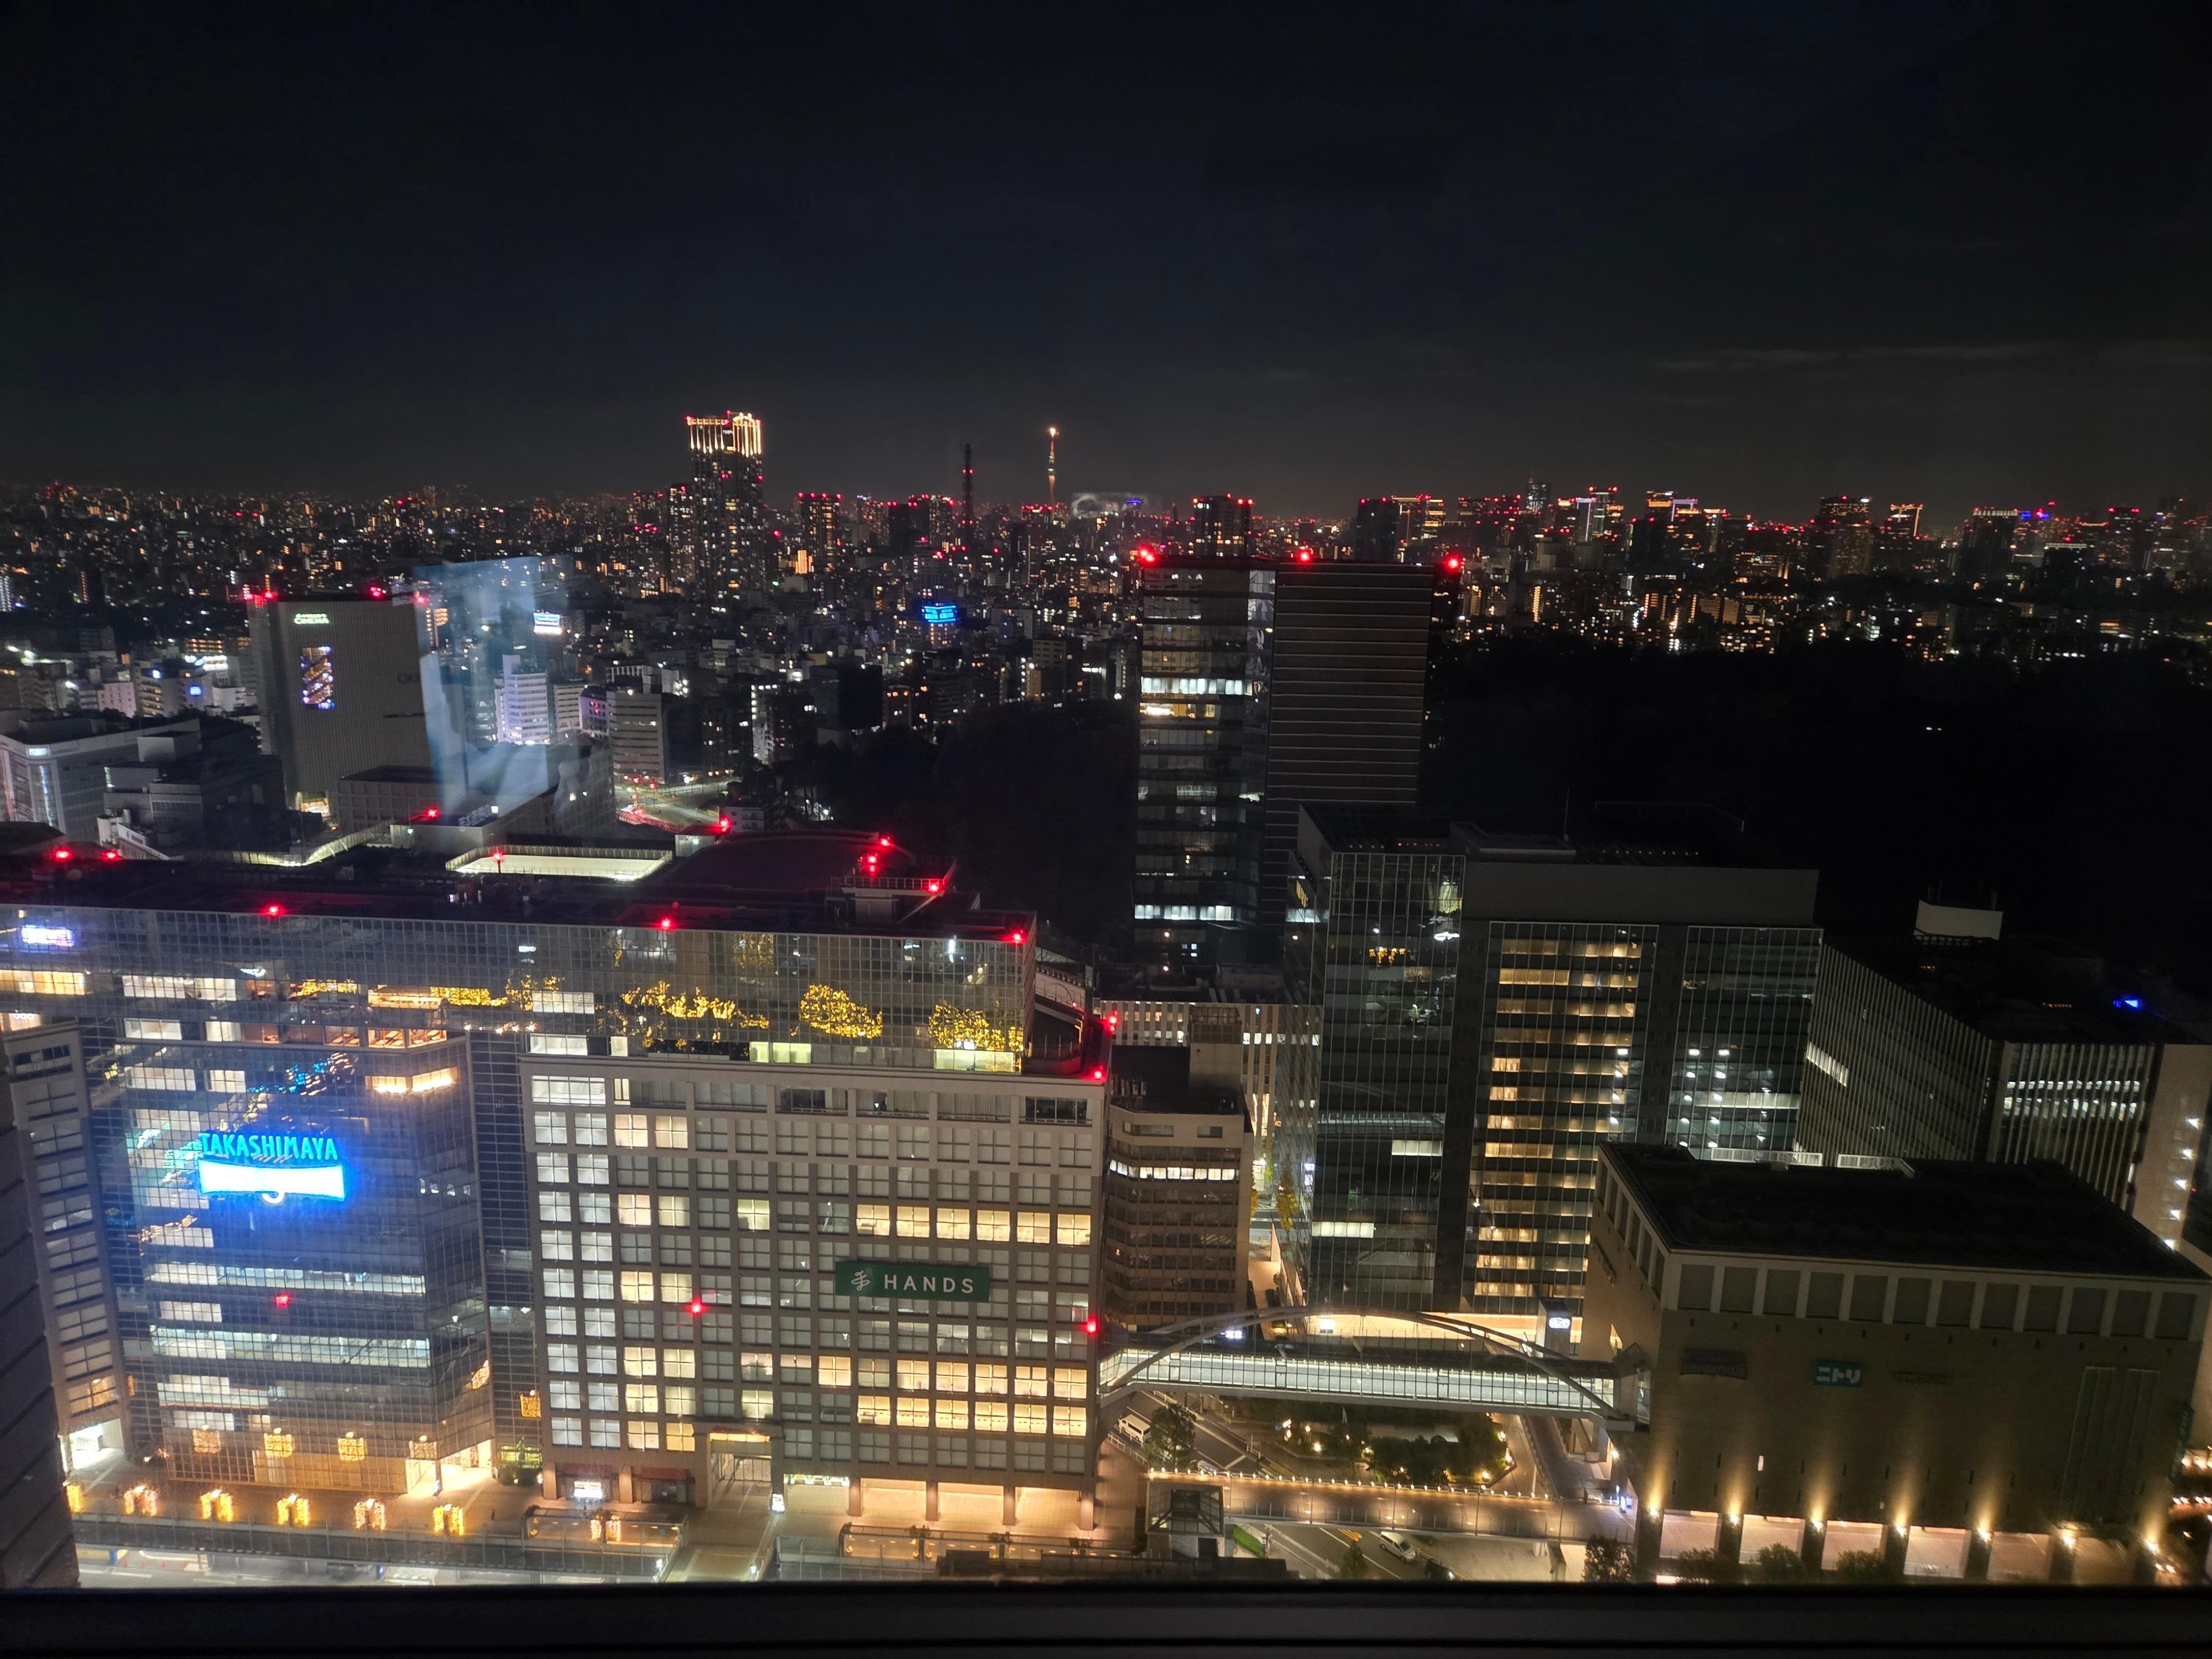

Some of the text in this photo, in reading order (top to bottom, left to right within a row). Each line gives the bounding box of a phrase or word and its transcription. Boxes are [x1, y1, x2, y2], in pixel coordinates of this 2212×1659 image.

[199, 1132, 338, 1160] TAKASHIMAYA
[884, 1274, 974, 1294] HANDS
[1816, 1366, 1861, 1384] ニトリ
